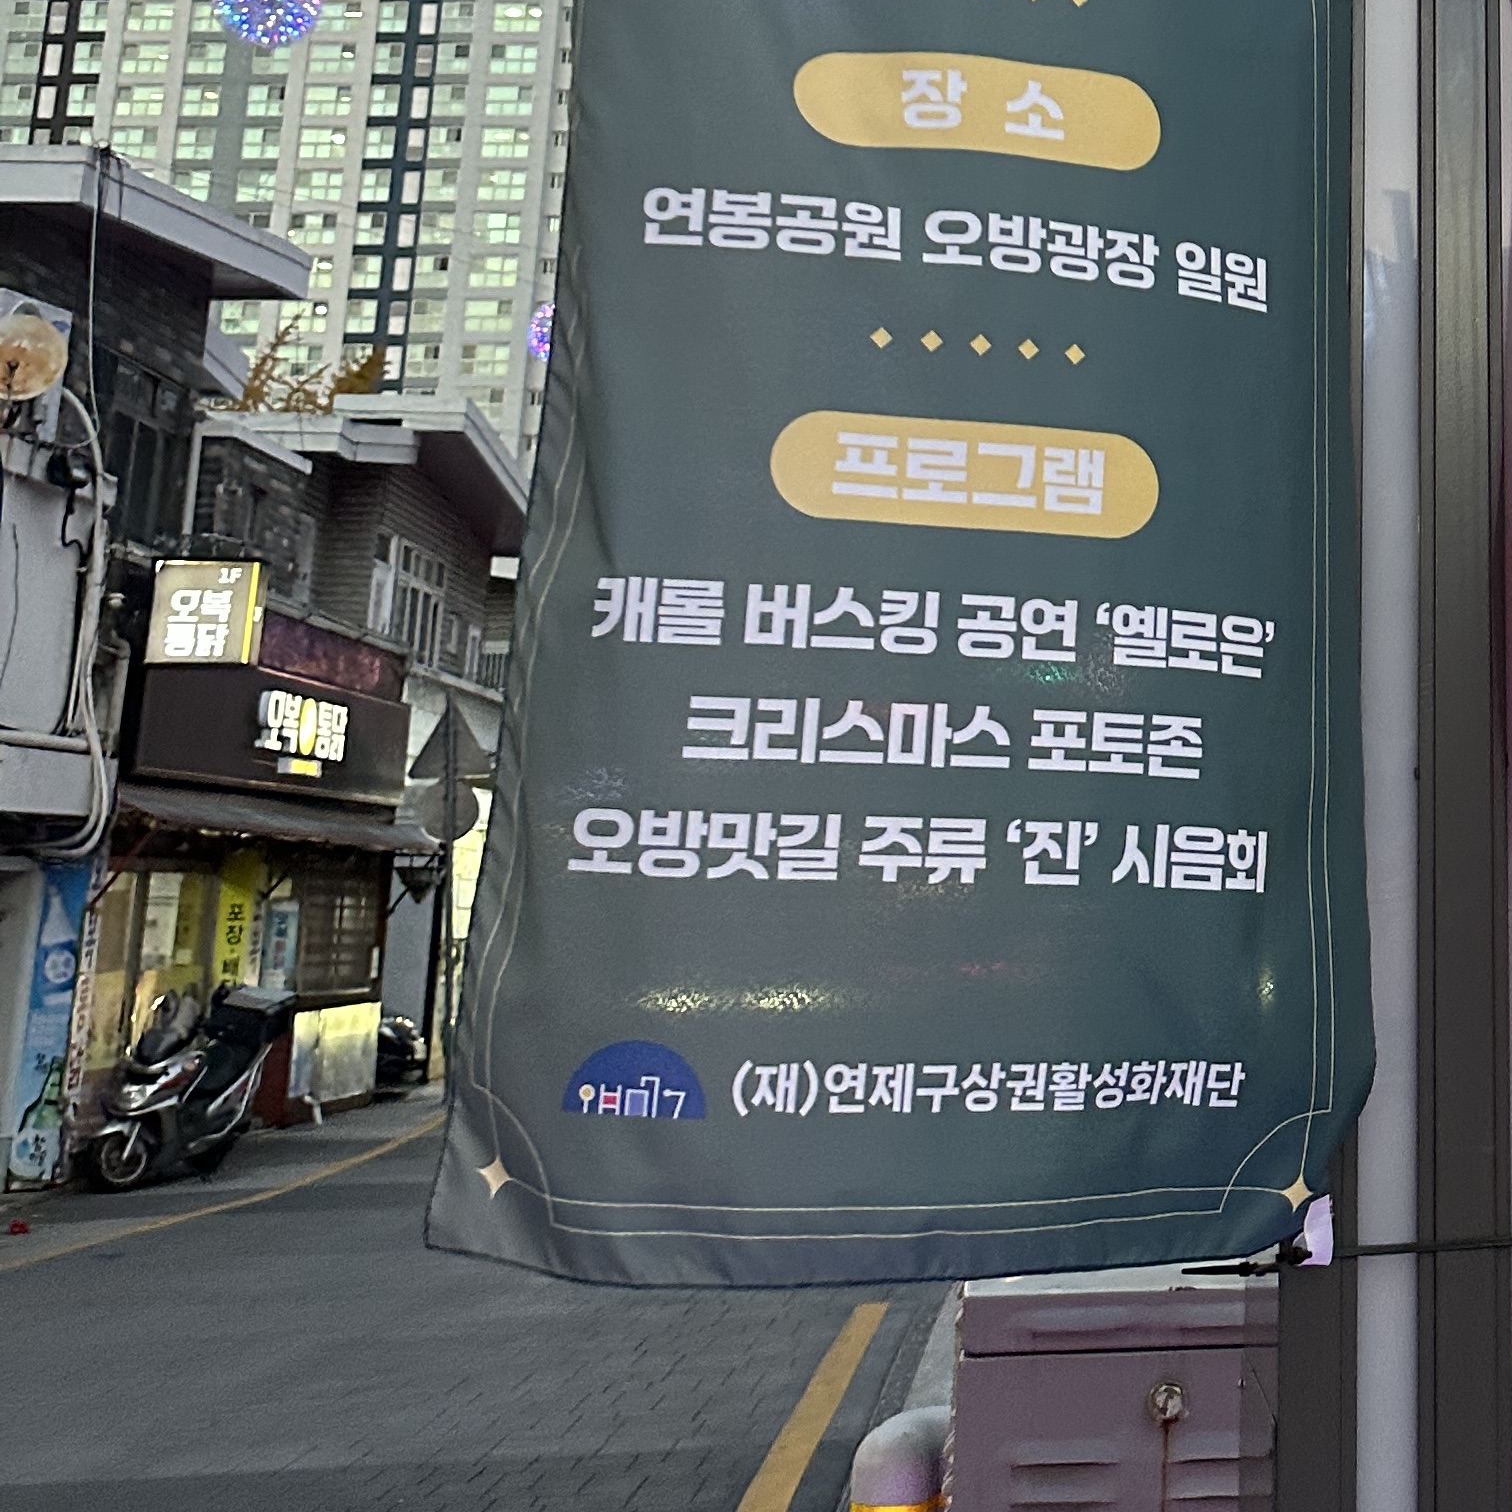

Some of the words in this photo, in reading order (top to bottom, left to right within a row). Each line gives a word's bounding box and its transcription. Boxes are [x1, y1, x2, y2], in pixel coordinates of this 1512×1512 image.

[642, 186, 901, 261] 연봉공원
[921, 209, 1159, 290] 오방광장
[1175, 240, 1268, 313] 일원
[832, 431, 1105, 516] 프로그램
[591, 576, 725, 646] 캐롤
[743, 583, 940, 655] 버스킹
[957, 593, 1079, 663] 공연
[681, 695, 1011, 769] 크리스마스
[1027, 709, 1202, 779] 포토존
[567, 807, 842, 882] 오방맛길
[859, 816, 988, 885] 주류
[1111, 823, 1268, 893] 시음회
[731, 1059, 1246, 1117] (재)연제구상권활성화재단
